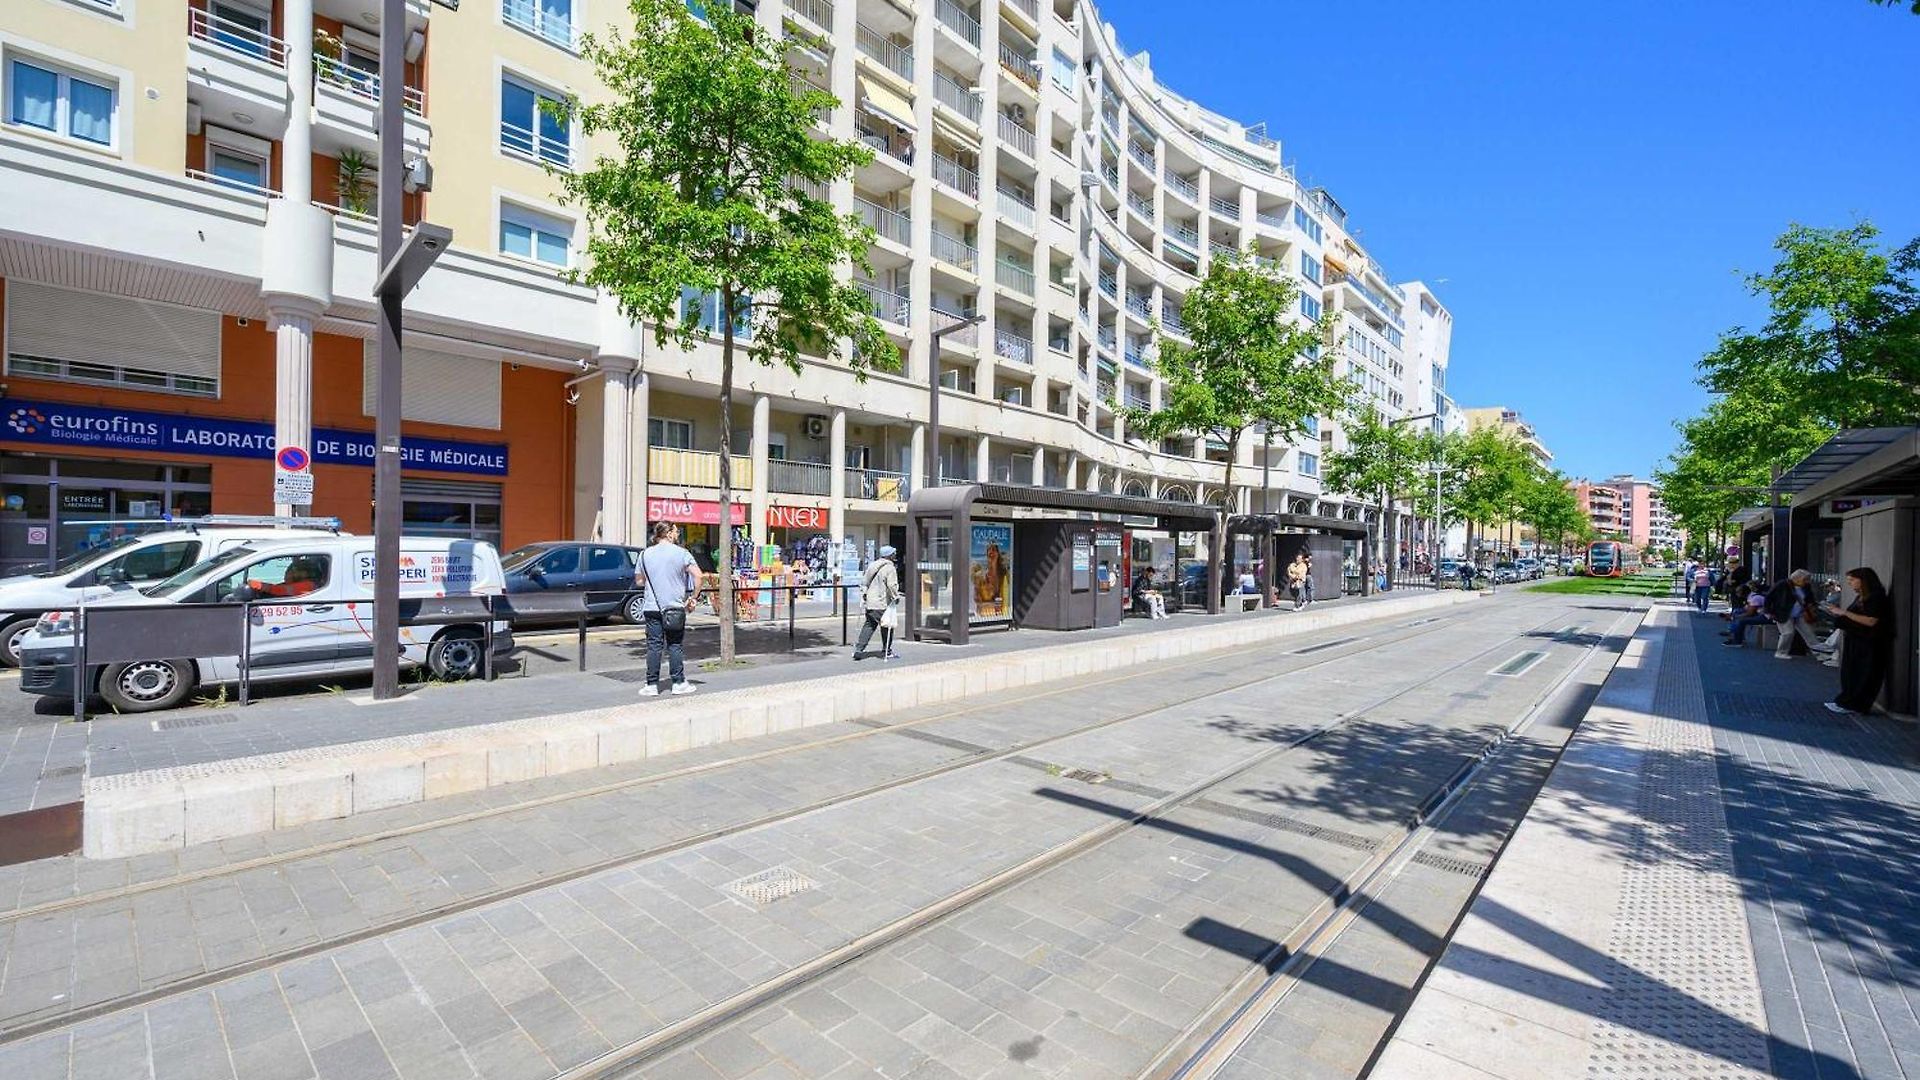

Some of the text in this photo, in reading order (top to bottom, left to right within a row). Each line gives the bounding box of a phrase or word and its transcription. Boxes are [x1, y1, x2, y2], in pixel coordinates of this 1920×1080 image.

[50, 414, 158, 435] eurofins
[51, 428, 158, 445] Biologie Médicale
[172, 427, 505, 468] LABORATO DE BIOGIE MÉDICALE
[361, 567, 427, 580] PRPERI
[290, 605, 303, 616] 95
